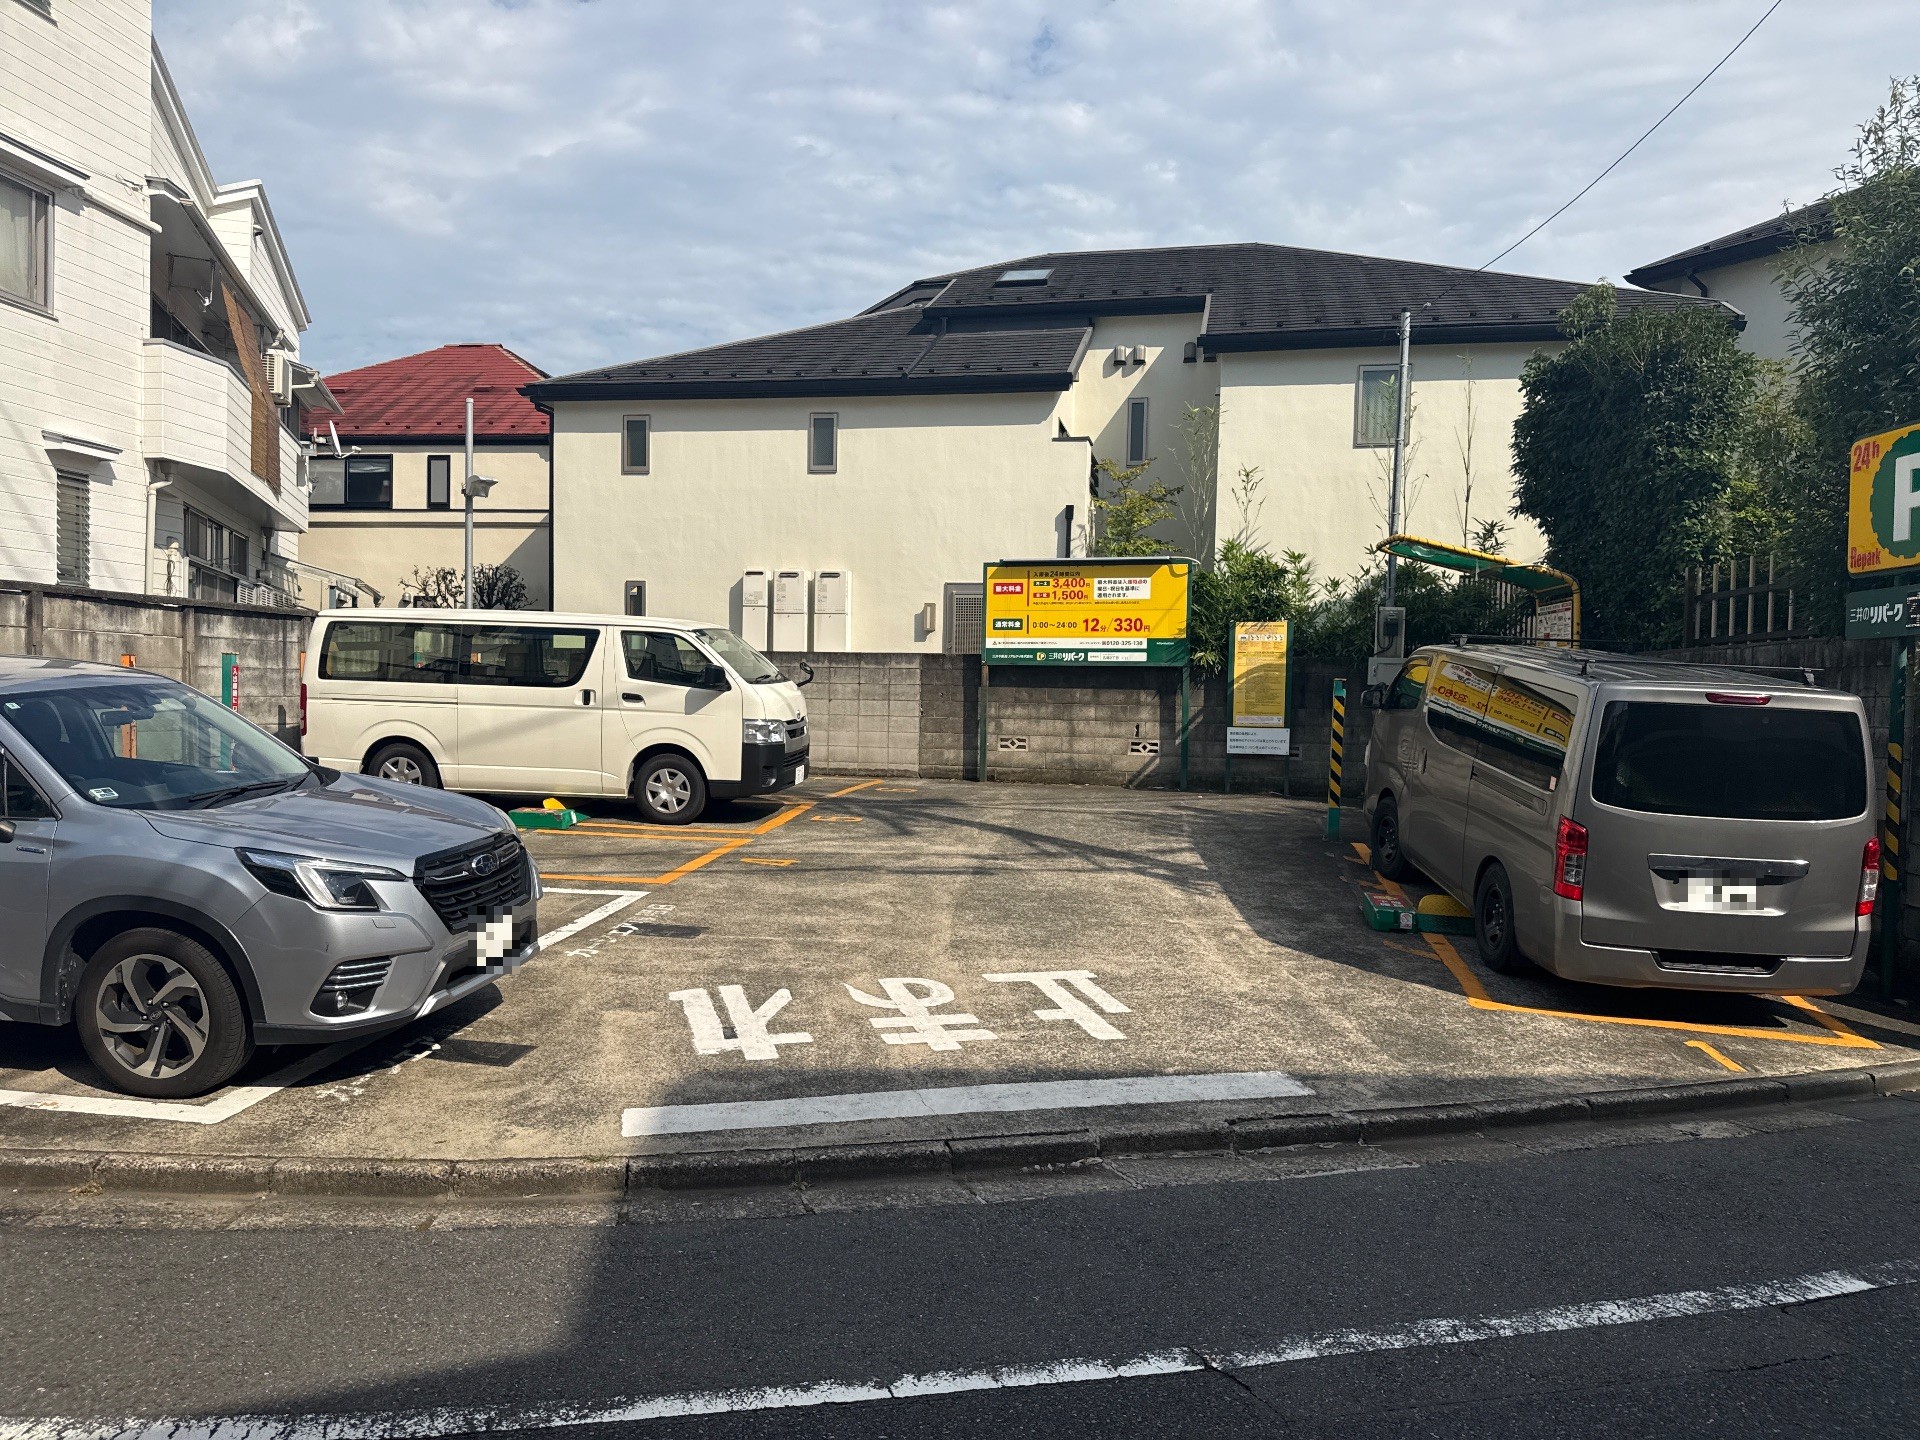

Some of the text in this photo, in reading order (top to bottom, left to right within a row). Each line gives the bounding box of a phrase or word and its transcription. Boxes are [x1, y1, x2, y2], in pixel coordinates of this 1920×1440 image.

[1850, 547, 1881, 570] Repark
[995, 585, 1022, 594] 最大料金
[1850, 603, 1903, 624] 三井のリパーク
[1048, 652, 1085, 662] 三井のリパーク
